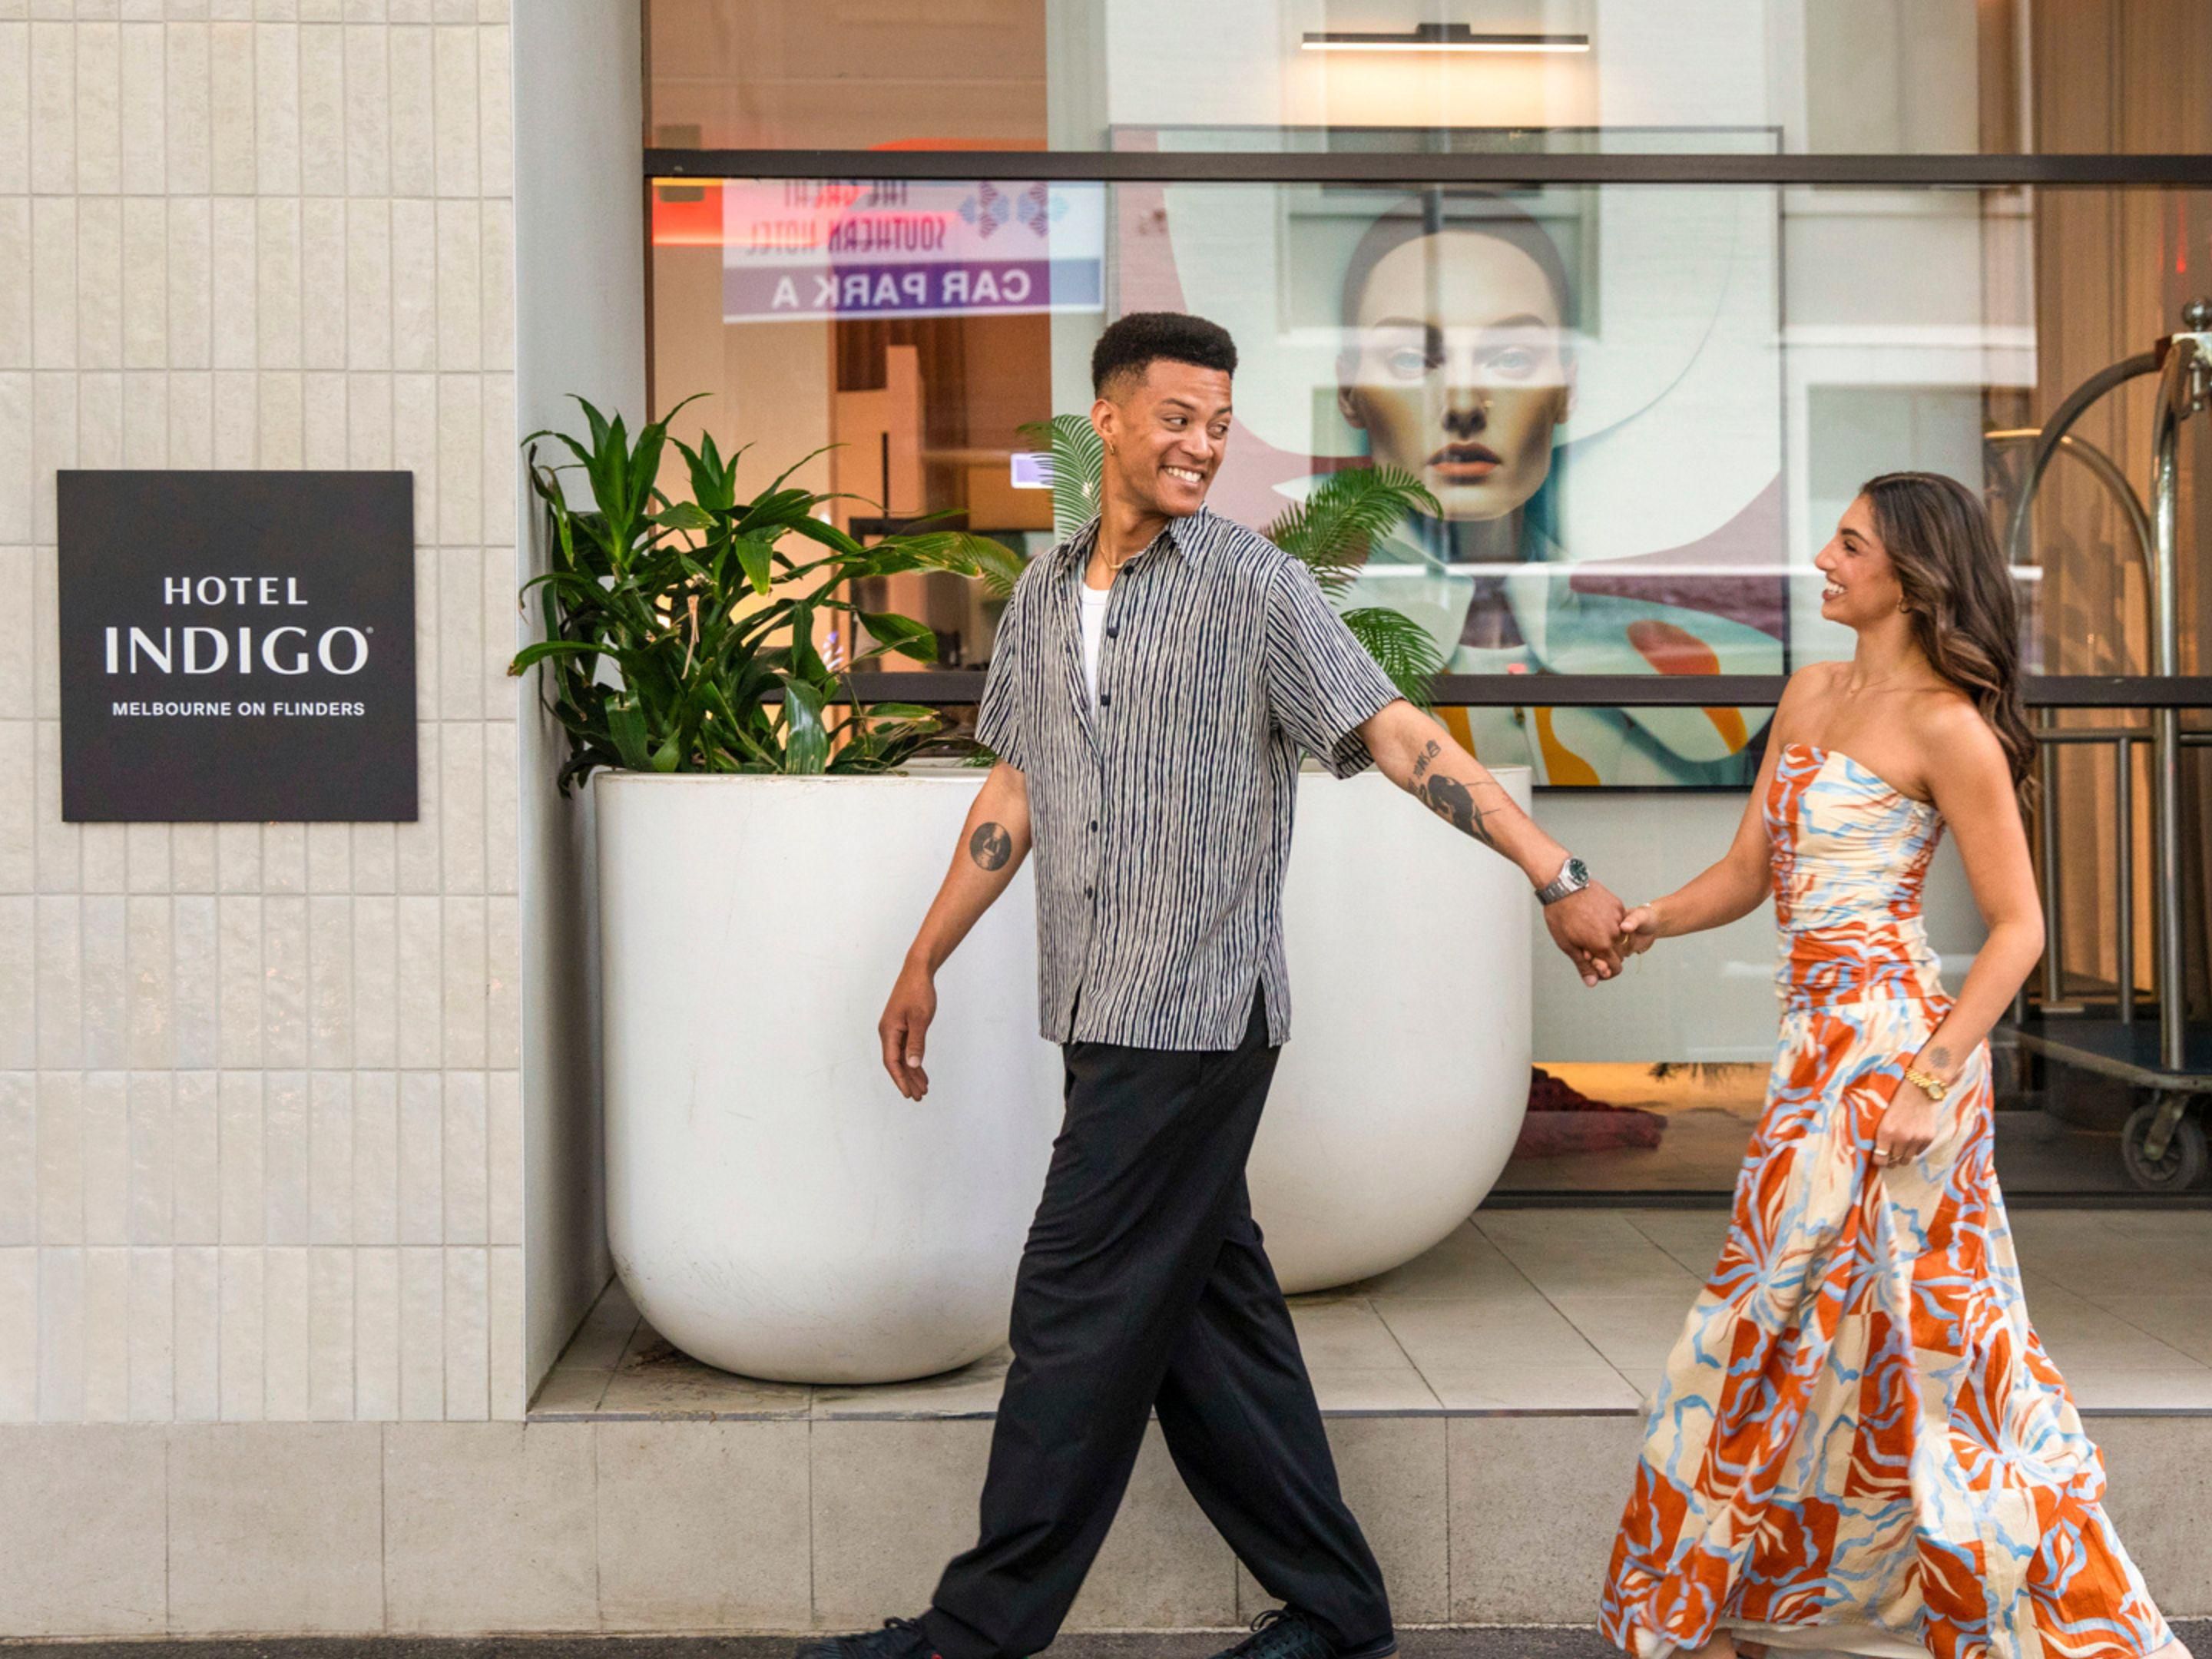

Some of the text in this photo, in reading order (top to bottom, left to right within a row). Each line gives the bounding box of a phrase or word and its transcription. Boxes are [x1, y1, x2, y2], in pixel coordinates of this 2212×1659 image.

[164, 576, 308, 605] HOTEL
[105, 626, 369, 675] INDIGO
[112, 702, 365, 716] MELBOURNE ON FLINDERS
